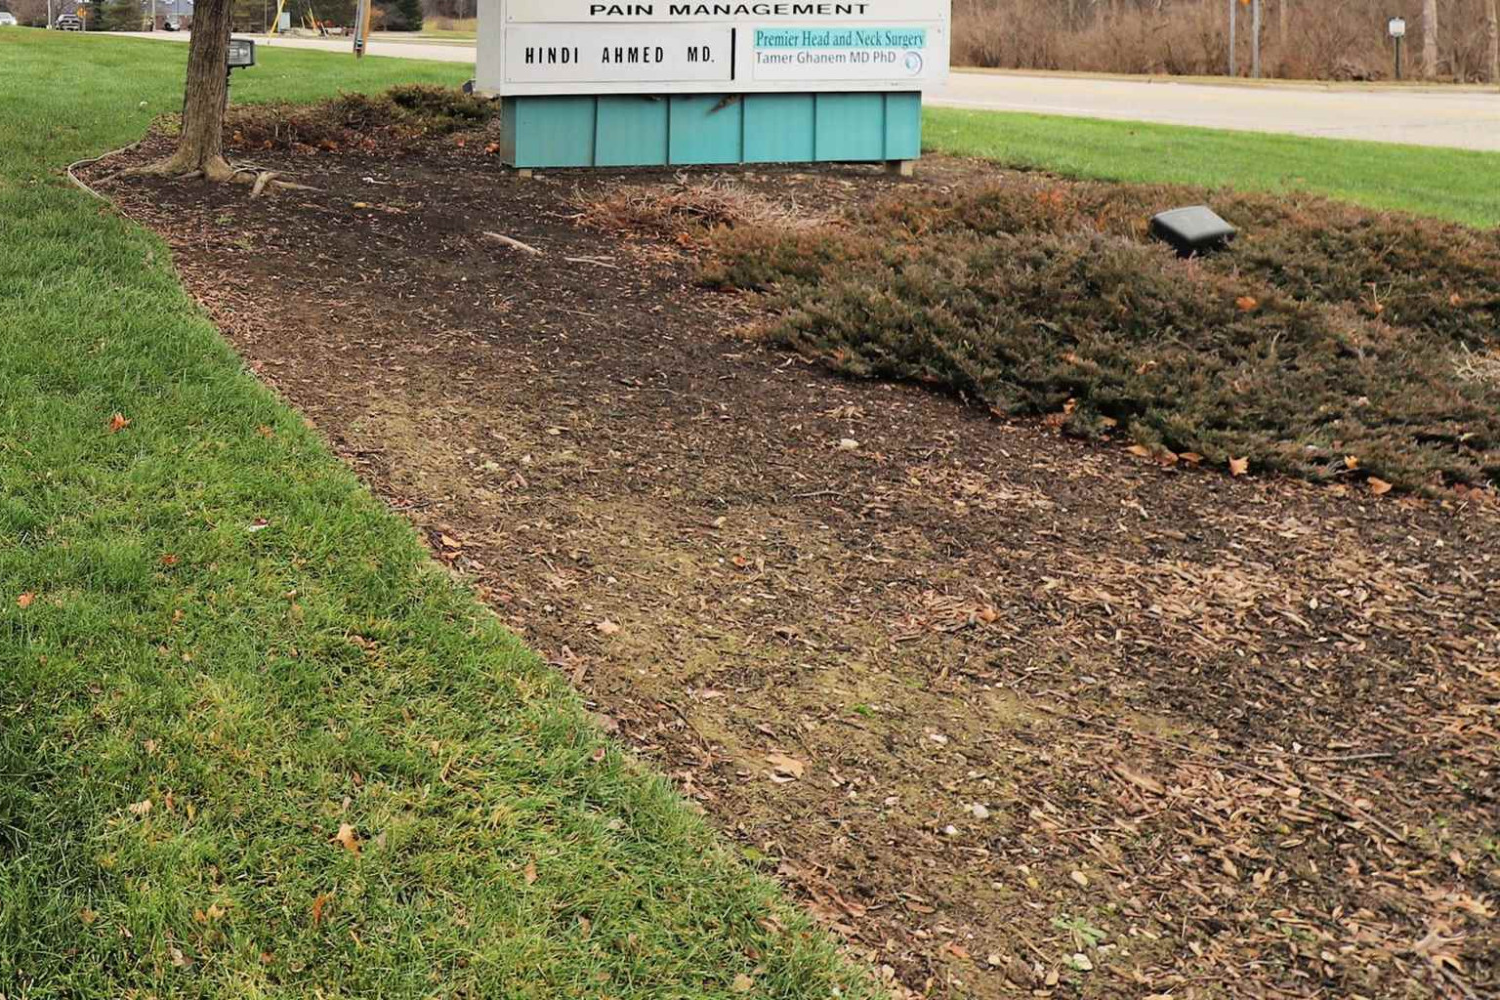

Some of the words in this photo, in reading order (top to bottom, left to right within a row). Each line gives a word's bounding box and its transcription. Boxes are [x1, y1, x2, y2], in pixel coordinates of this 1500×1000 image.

[590, 4, 653, 15] PAIN
[669, 4, 869, 15] MANAGEMENT
[756, 30, 798, 46] Premier
[802, 31, 829, 47] Head
[833, 31, 851, 47] and
[856, 31, 882, 47] Neck
[885, 31, 924, 50] Surgery
[525, 47, 578, 64] HINDI
[602, 47, 663, 63] AHMED
[687, 46, 715, 63] MD.
[756, 52, 794, 63] Tamer
[797, 52, 846, 63] Ghanem
[850, 52, 870, 63] MD
[873, 52, 896, 63] PhD
